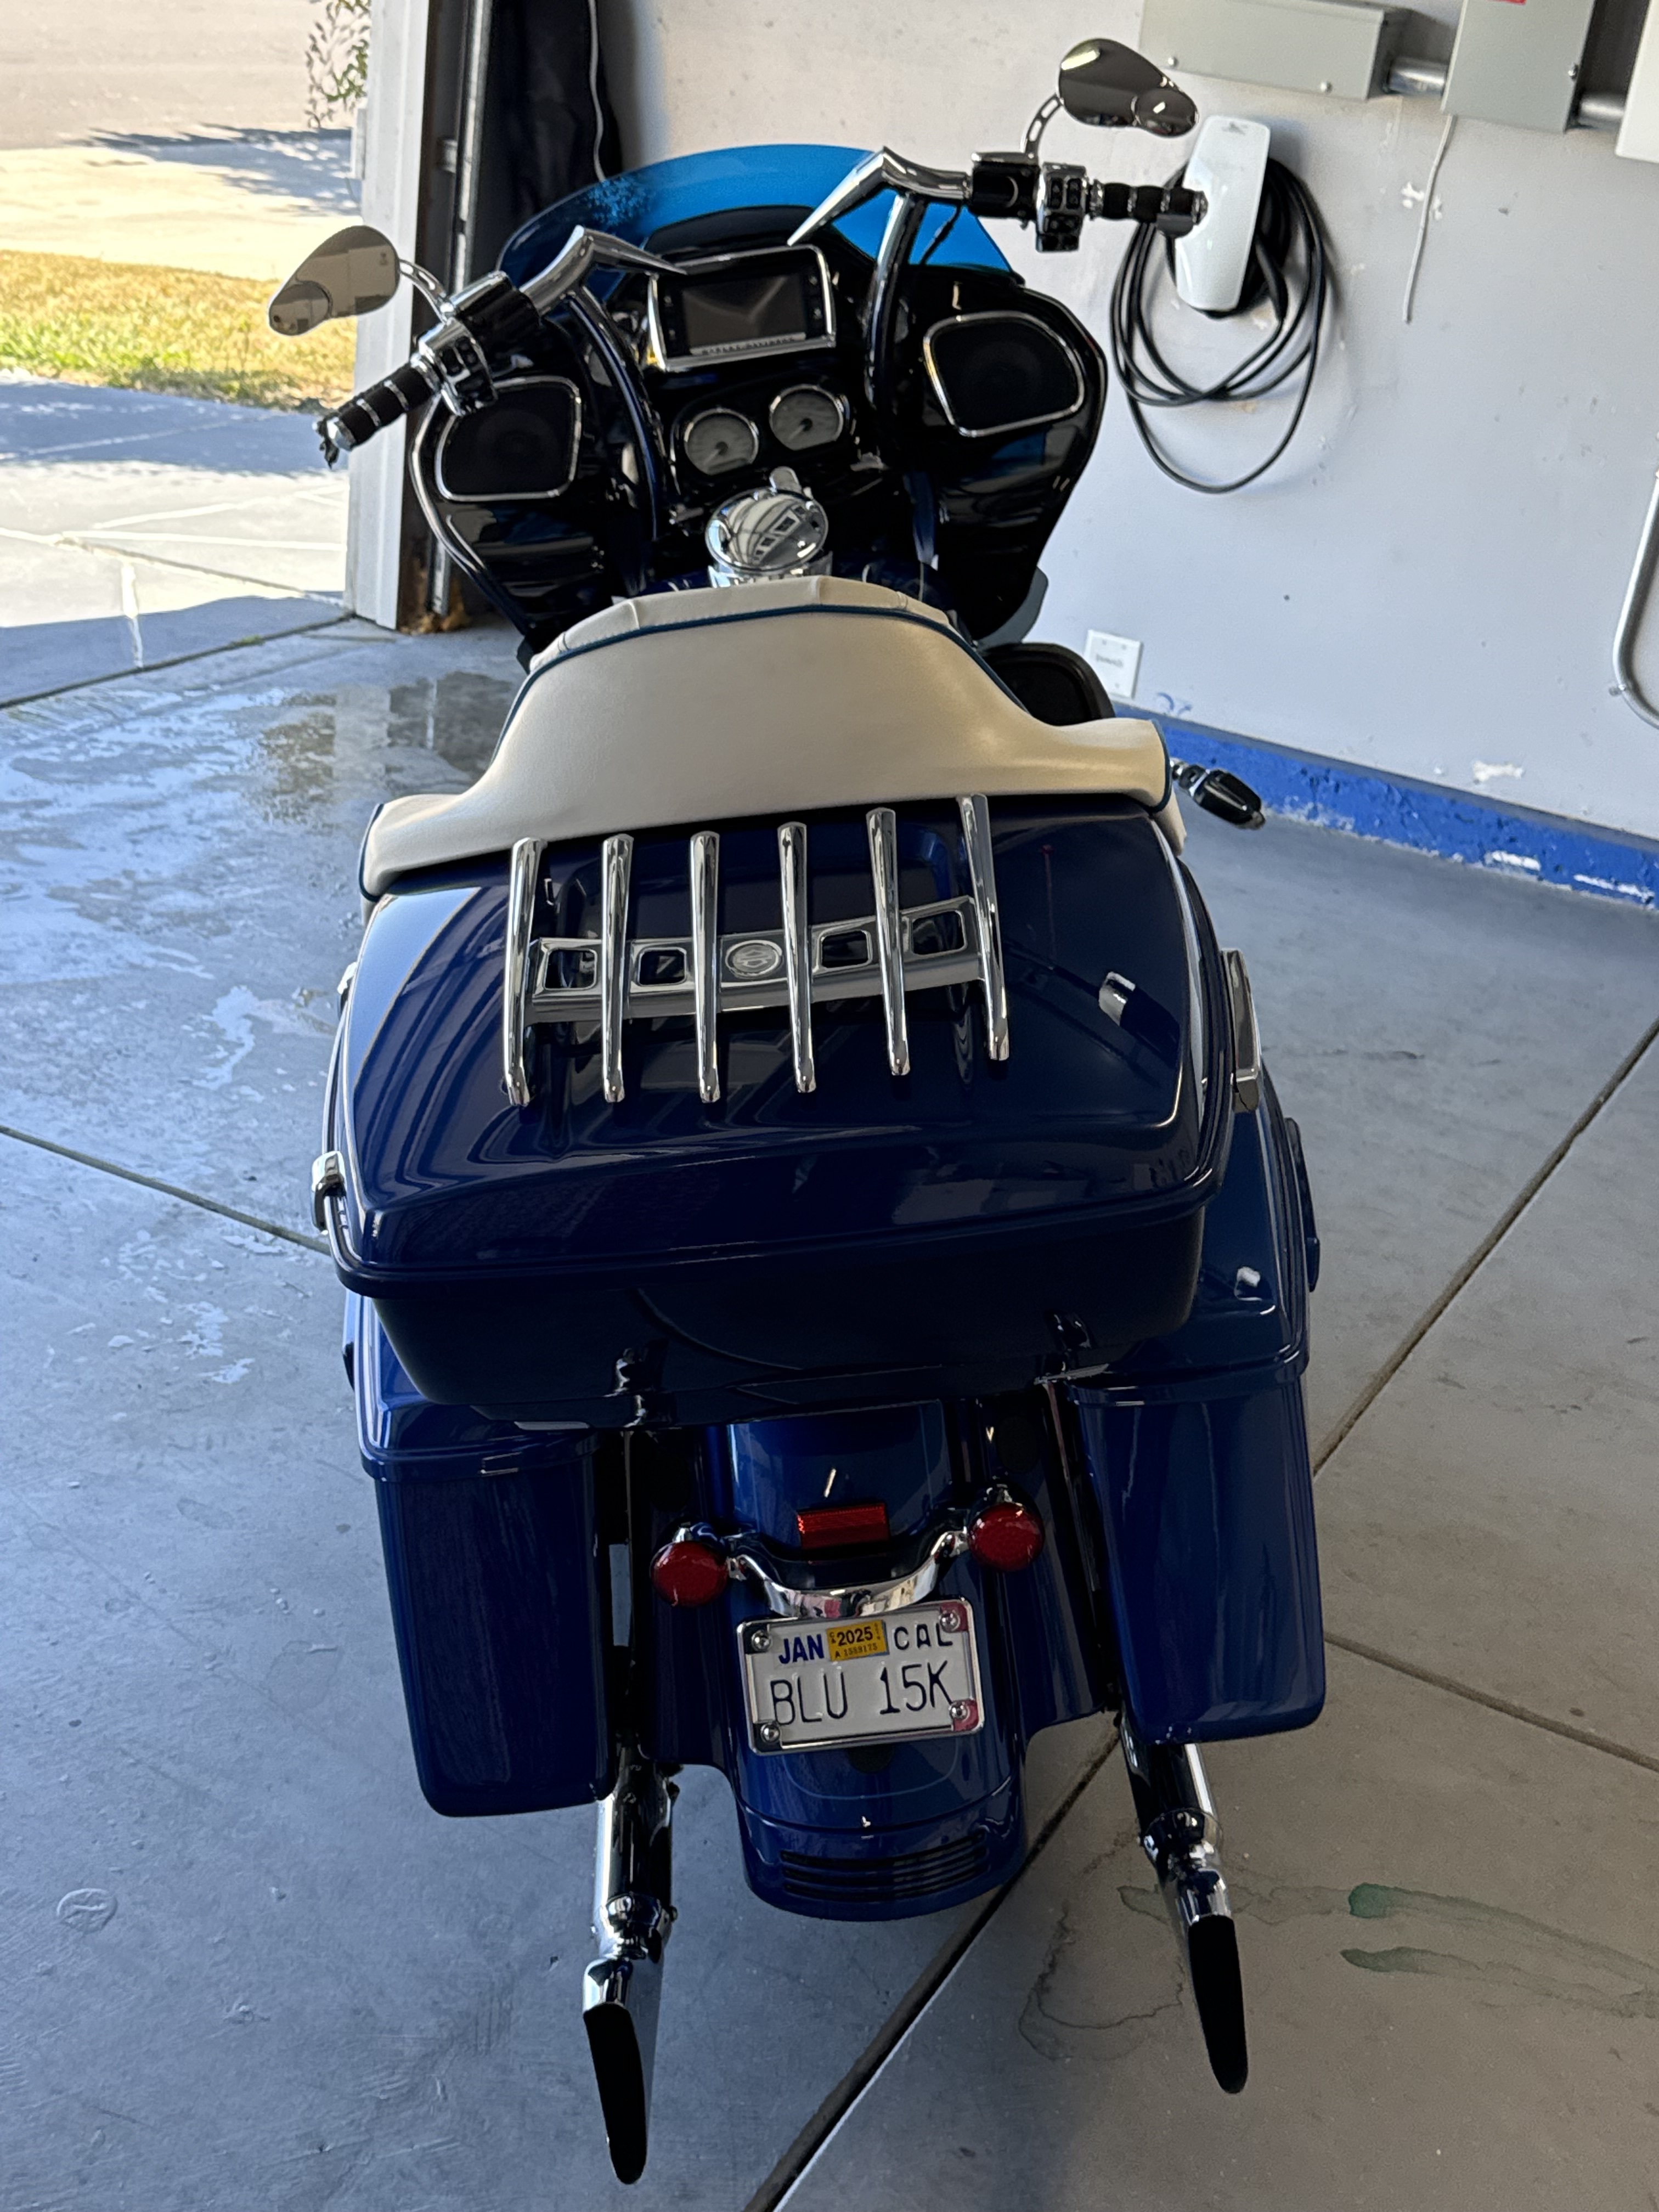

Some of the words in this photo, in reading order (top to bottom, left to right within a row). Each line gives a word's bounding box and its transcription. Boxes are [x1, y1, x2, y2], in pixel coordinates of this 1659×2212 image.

[778, 1634, 825, 1664] JAN
[837, 1626, 873, 1646] 2025
[894, 1623, 953, 1650] CAL
[770, 1672, 849, 1726] BLU
[880, 1660, 953, 1714] 15K
